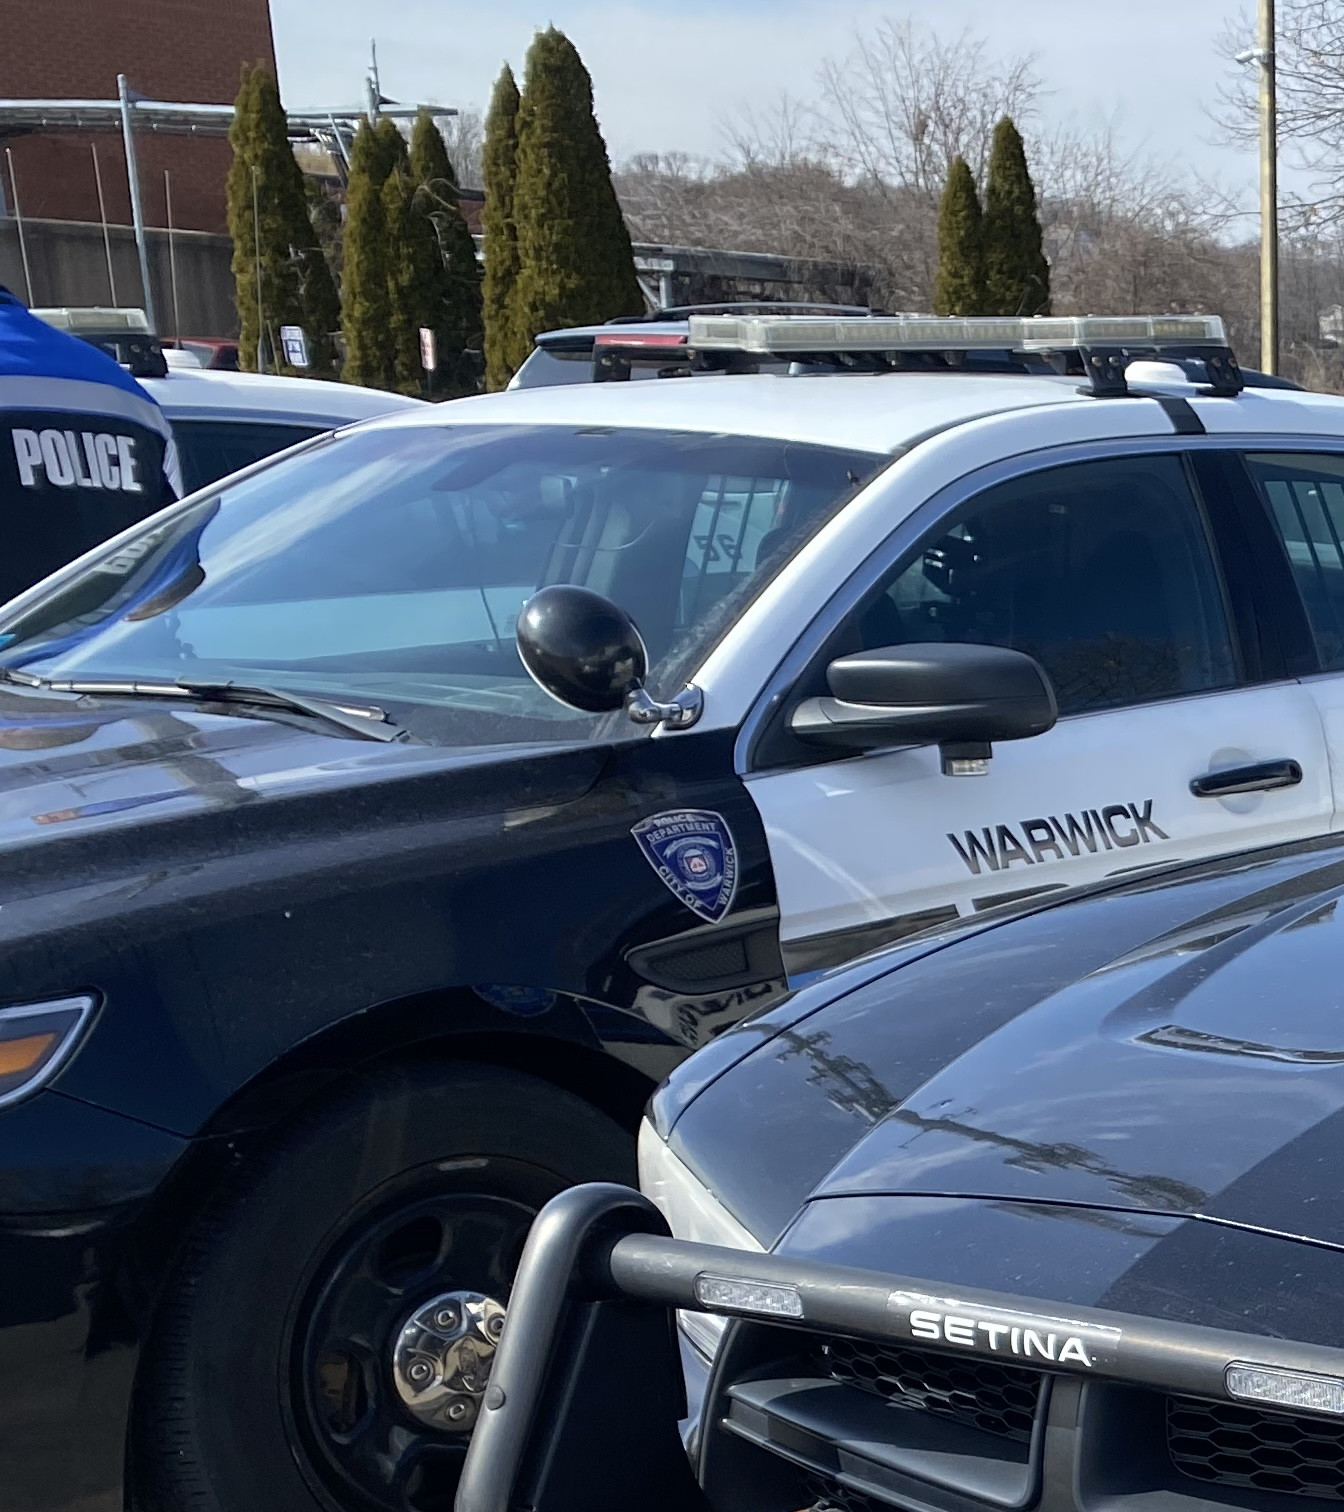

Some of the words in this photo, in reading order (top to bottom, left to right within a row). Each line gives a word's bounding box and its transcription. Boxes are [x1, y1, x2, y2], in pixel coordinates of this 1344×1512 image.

[12, 428, 142, 491] POLICE
[646, 822, 715, 842] DEPARTMENT
[946, 799, 1171, 875] WARWICK
[658, 865, 685, 893] CITY
[684, 894, 702, 909] OF
[719, 847, 735, 905] WARWICK
[910, 1310, 1092, 1367] SETINA
